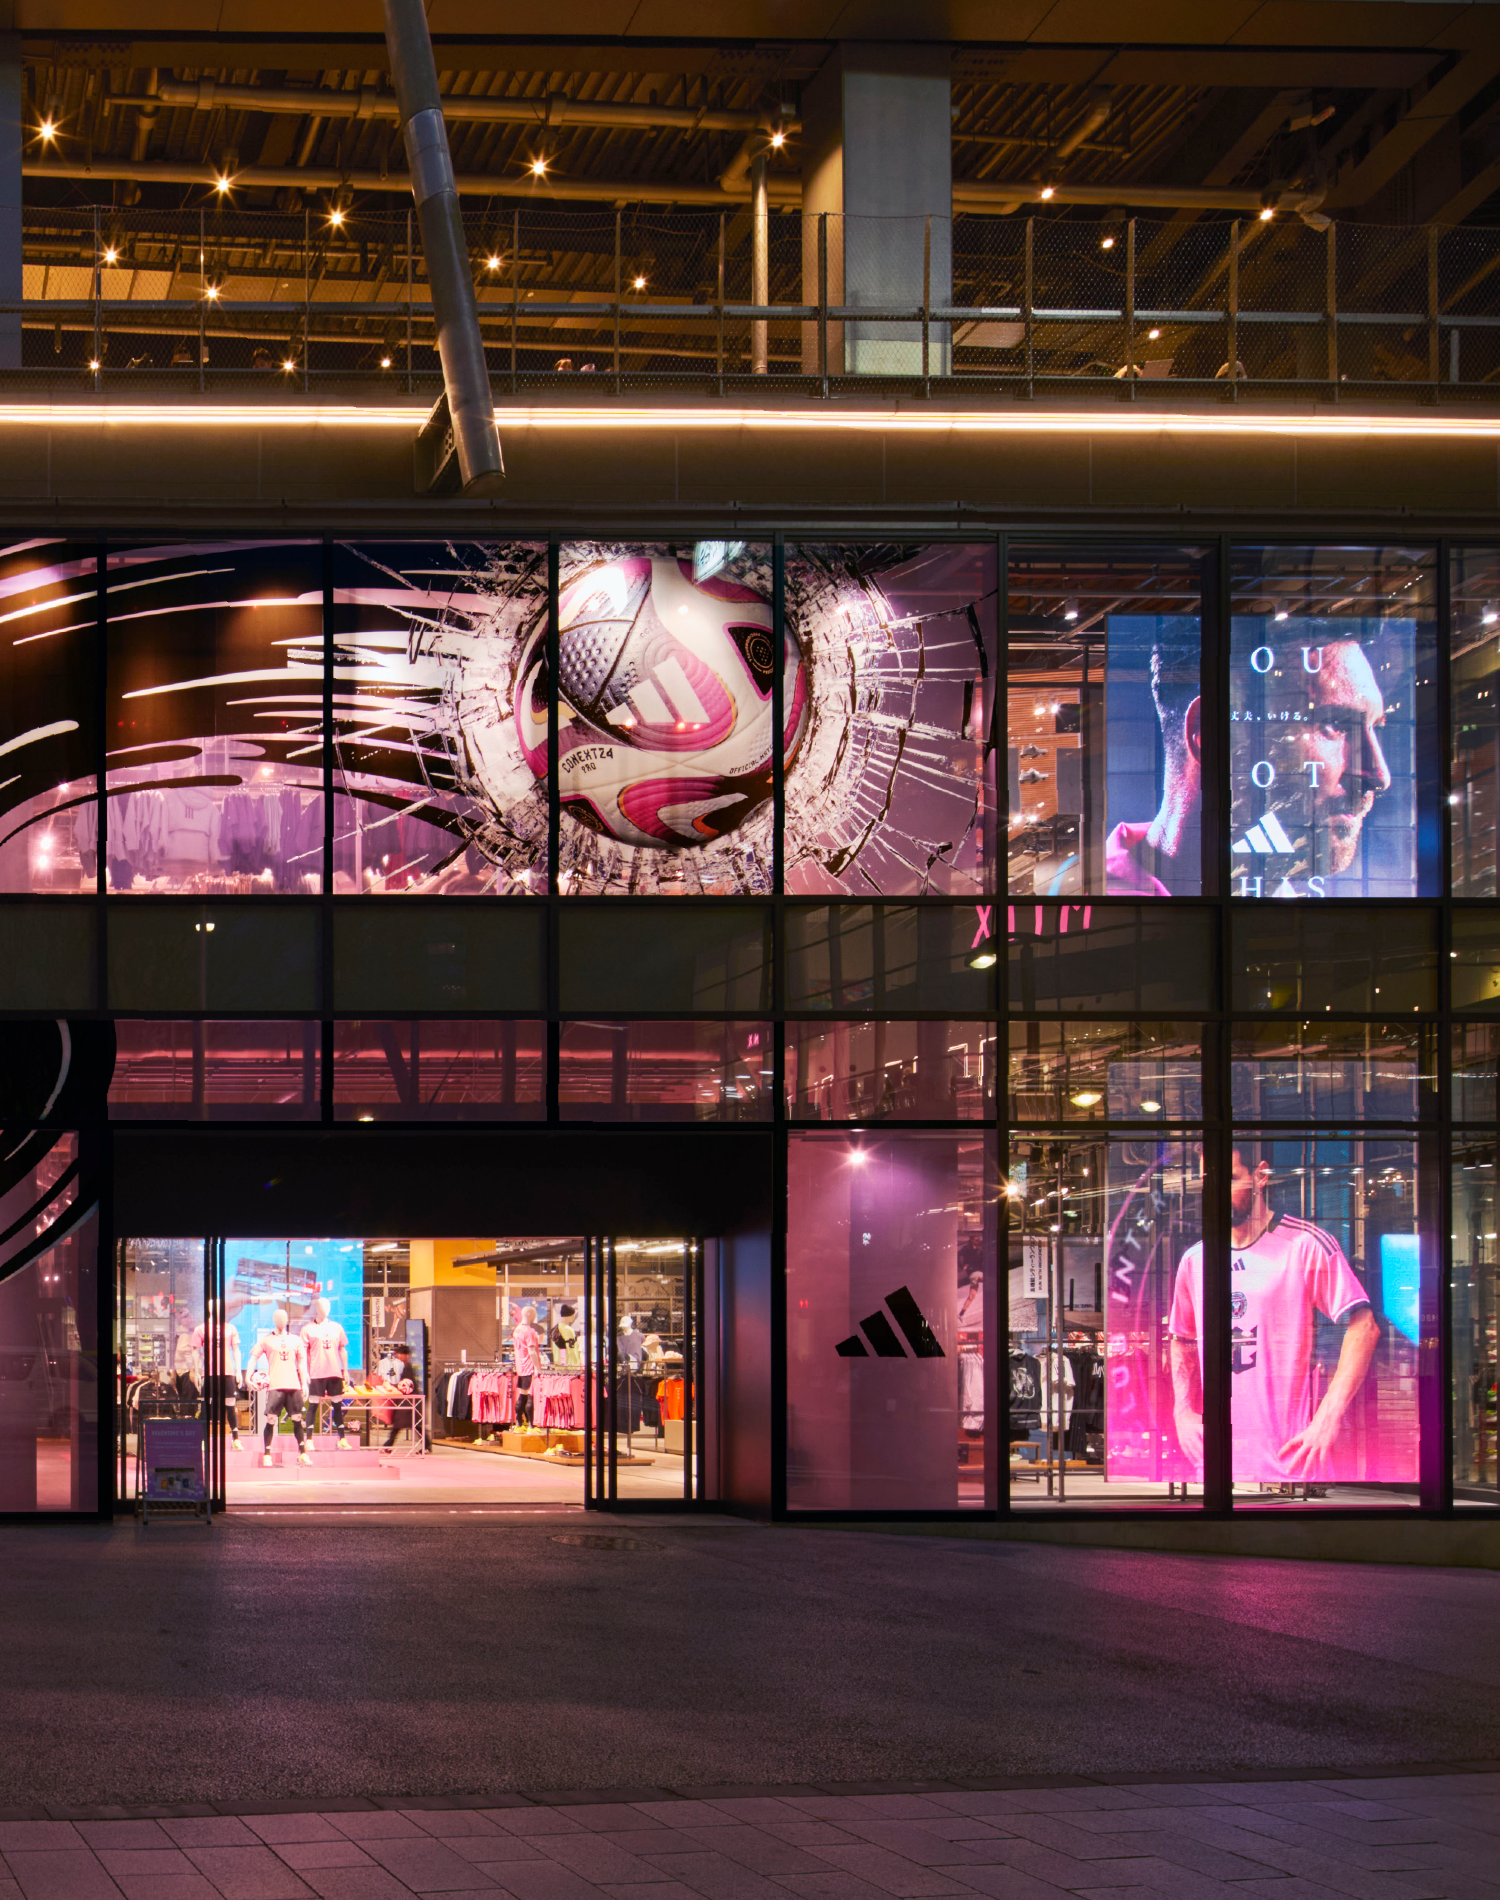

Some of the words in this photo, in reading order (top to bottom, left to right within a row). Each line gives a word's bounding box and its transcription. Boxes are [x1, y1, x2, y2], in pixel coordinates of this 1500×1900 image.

[1250, 646, 1324, 673] OU
[561, 747, 614, 773] CONEXT24
[581, 762, 597, 773] PRO
[729, 760, 759, 774] OFFICIAL
[1251, 761, 1325, 788] OT
